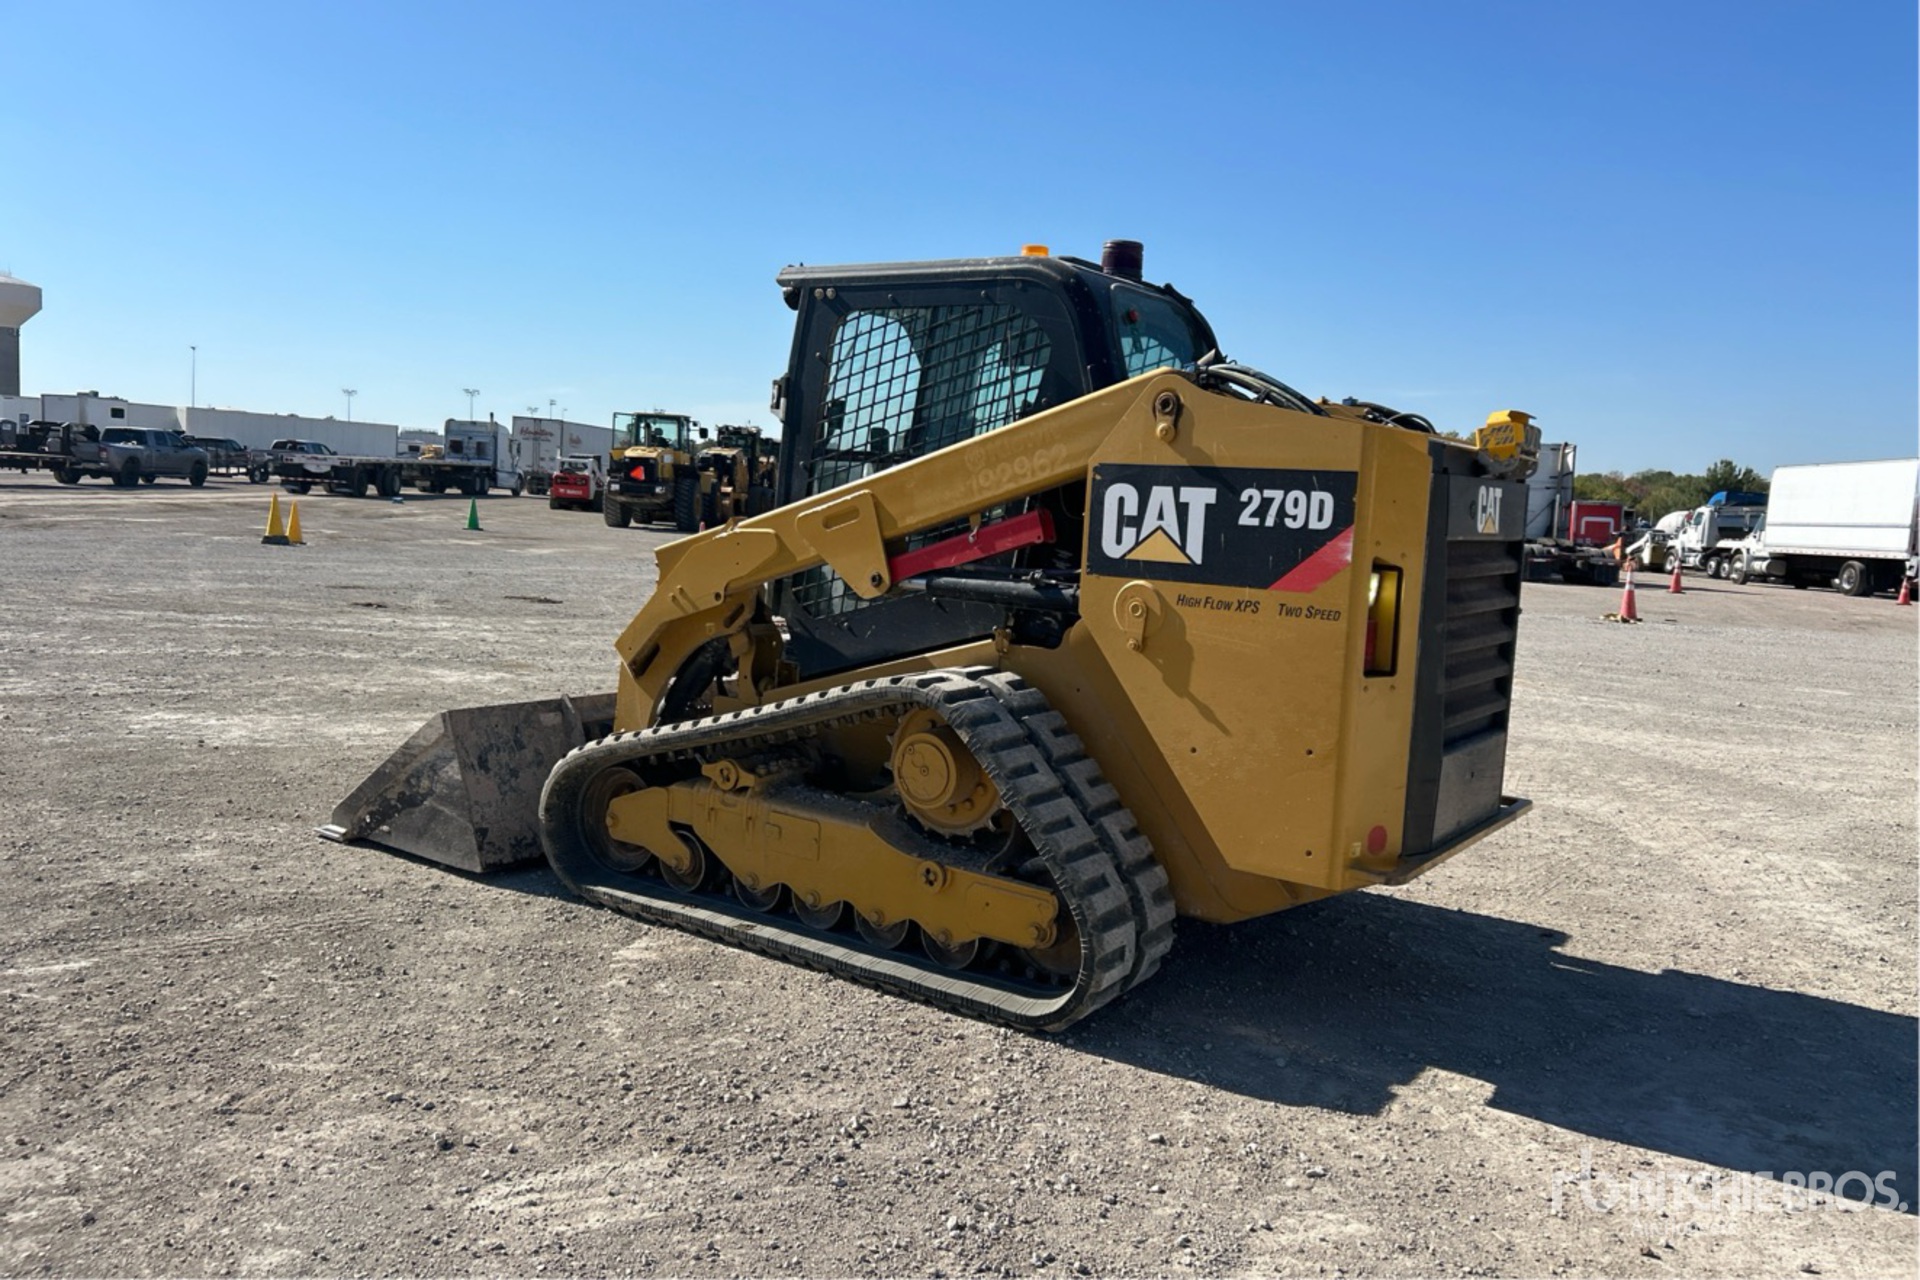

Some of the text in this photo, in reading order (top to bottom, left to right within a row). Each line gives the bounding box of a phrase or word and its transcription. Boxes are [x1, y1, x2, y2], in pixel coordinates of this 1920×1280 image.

[1101, 483, 1334, 565] CAT 279D
[1477, 485, 1502, 534] CAT
[1176, 593, 1260, 614] HIGH FLOW XPS
[1278, 603, 1342, 622] TWO SPEED
